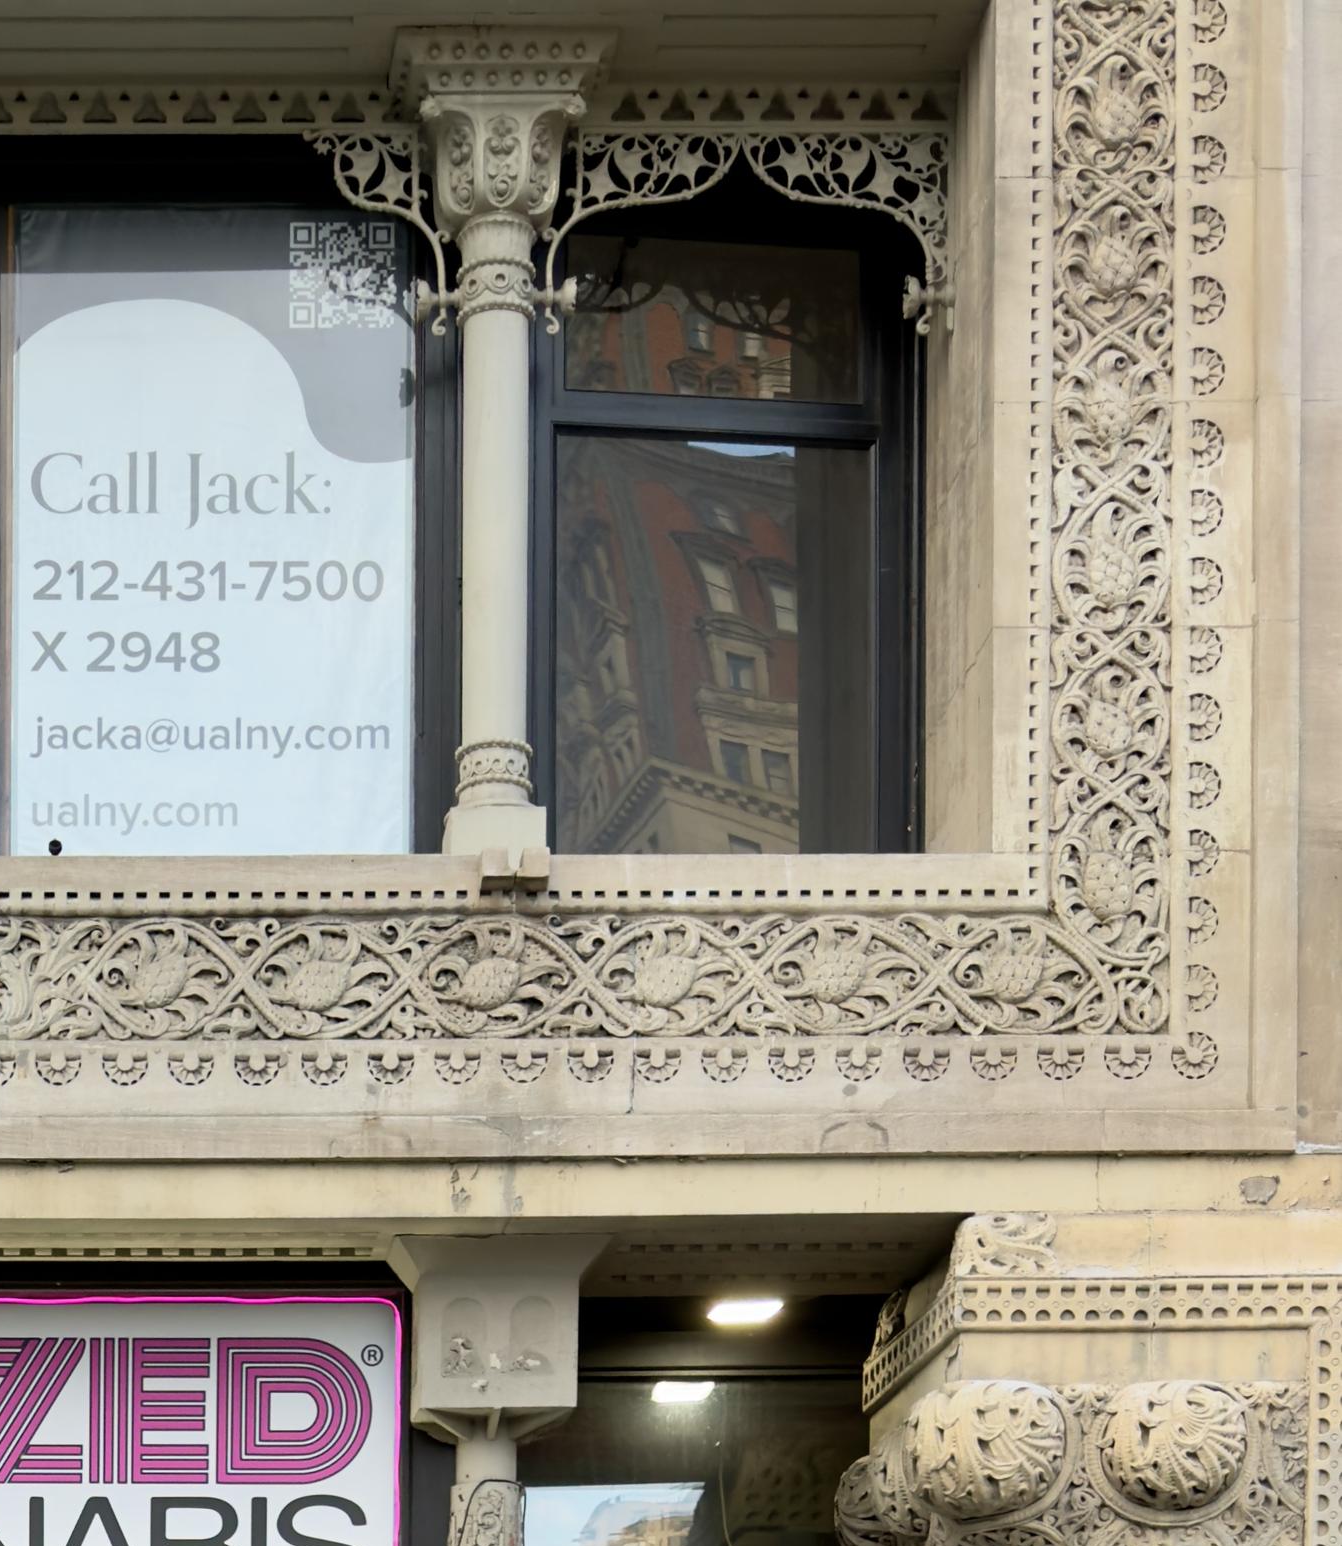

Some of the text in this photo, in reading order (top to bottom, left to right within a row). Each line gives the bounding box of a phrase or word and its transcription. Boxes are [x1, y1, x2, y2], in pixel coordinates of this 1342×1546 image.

[31, 450, 333, 530] Call Jack:
[32, 559, 385, 603] 212-431-7500
[31, 630, 222, 674] X 2948
[30, 715, 392, 760] jacka@ualny.com
[30, 793, 240, 836] ualny.com
